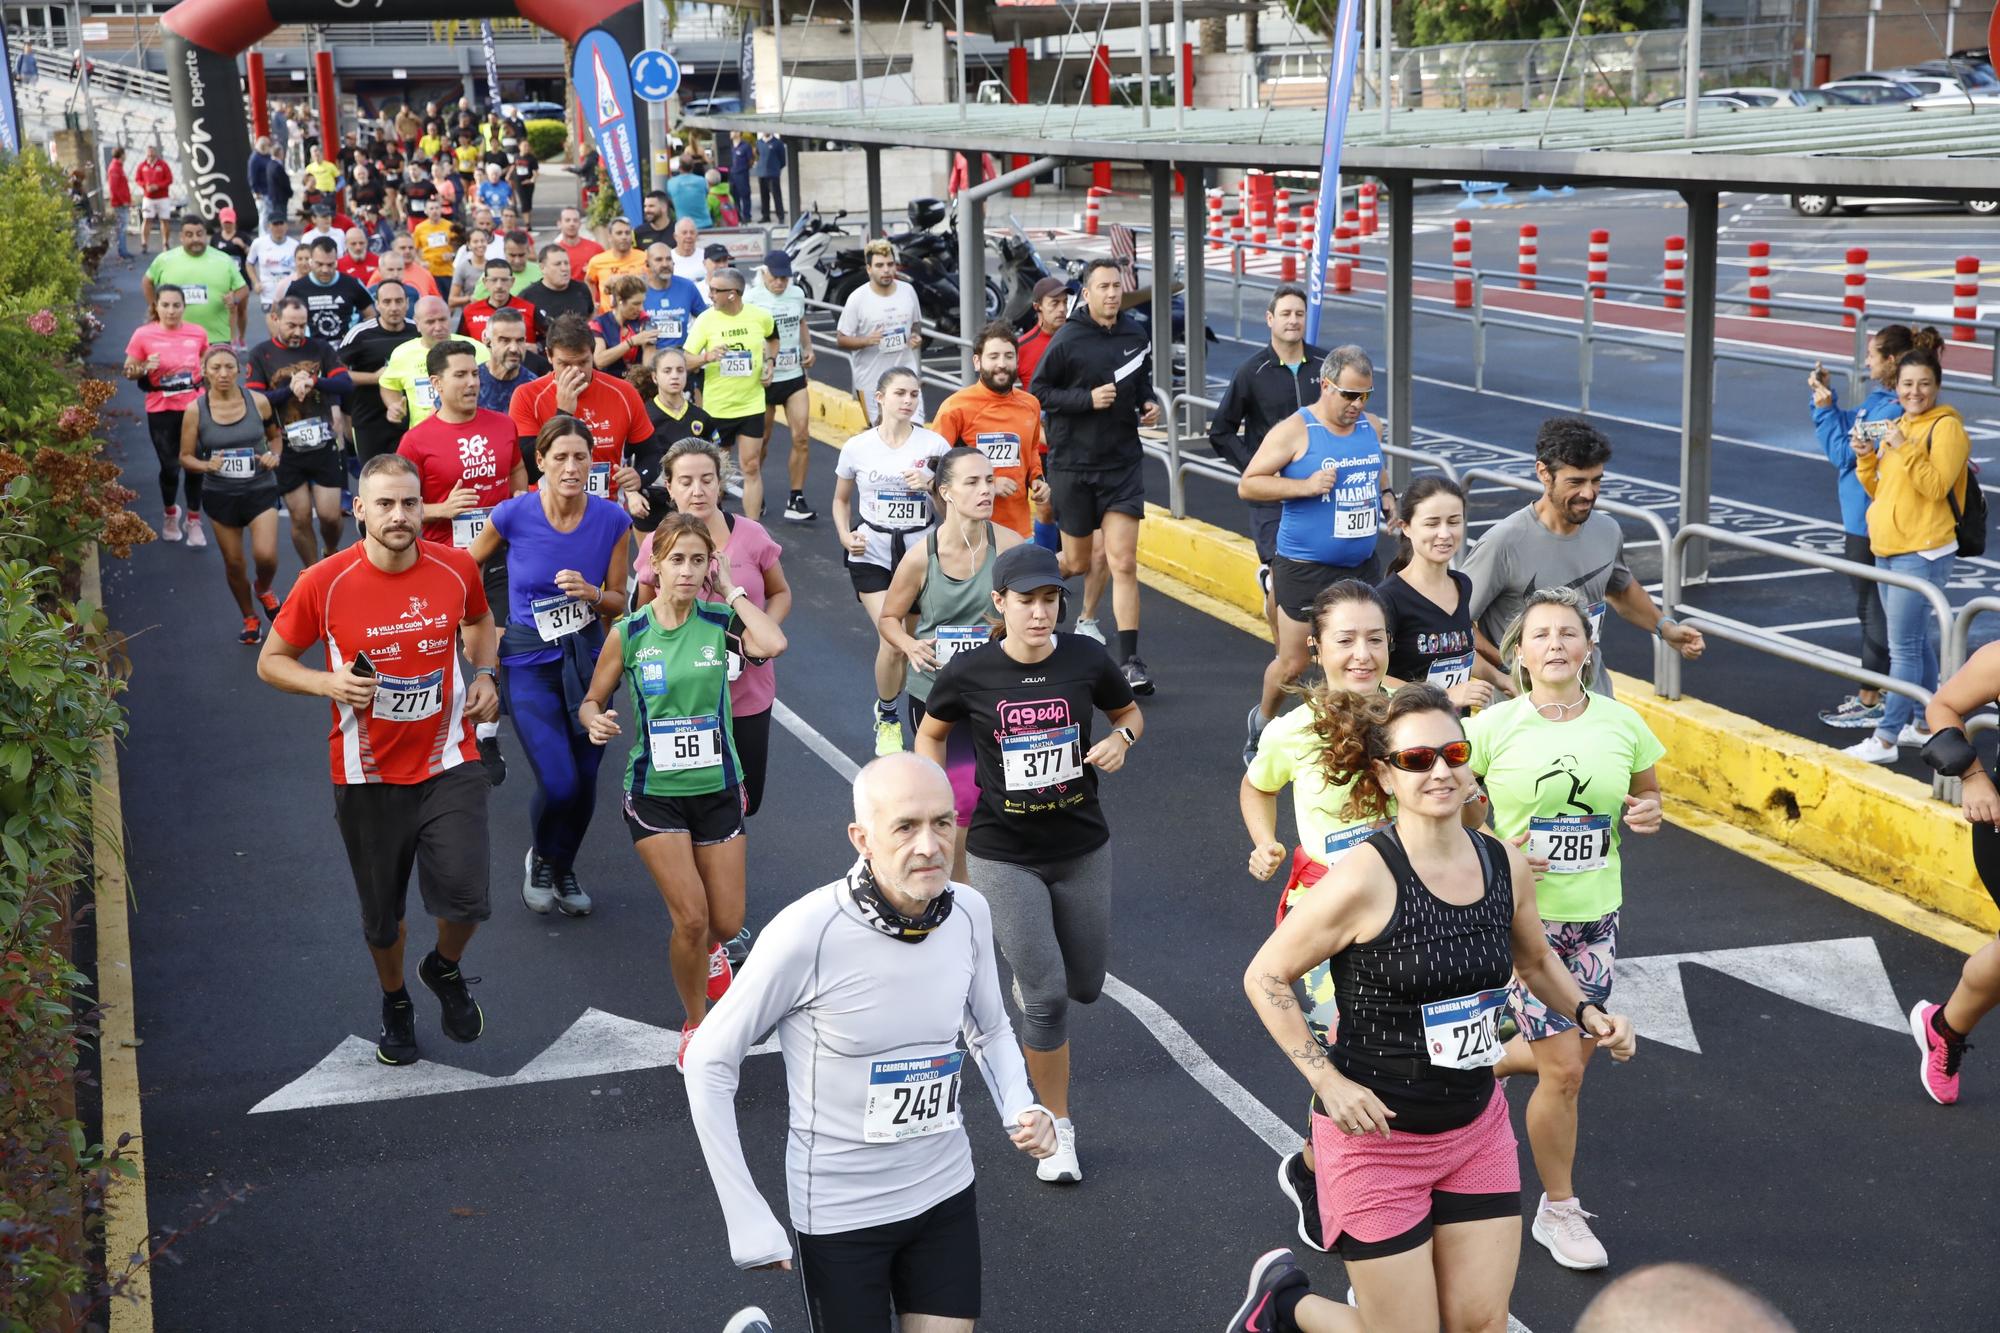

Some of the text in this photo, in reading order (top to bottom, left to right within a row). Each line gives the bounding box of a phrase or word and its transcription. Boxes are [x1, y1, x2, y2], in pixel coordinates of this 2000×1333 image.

[186, 50, 206, 107] Deporte
[885, 335, 901, 348] 229
[727, 360, 745, 371] 255
[300, 429, 314, 443] 53
[457, 435, 482, 461] 36
[988, 444, 1012, 460] 222
[224, 459, 243, 472] 219
[462, 455, 487, 467] VILLA
[1322, 456, 1380, 470] mediolanum
[463, 464, 496, 482] GIJÓN
[1335, 482, 1377, 502] MARIÑA
[887, 502, 915, 519] 239
[1347, 511, 1371, 531] 307
[549, 603, 583, 629] 374
[366, 627, 380, 637] 34
[404, 621, 423, 629] GIJÓN
[635, 646, 663, 663] gijón
[694, 660, 711, 668] Santa
[391, 690, 430, 713] 277
[1029, 733, 1048, 742] POPULAR
[1029, 740, 1054, 750] MARINA
[674, 735, 699, 759] 56
[1023, 748, 1063, 778] 377
[1552, 824, 1591, 832] SUPERGIRL
[1548, 834, 1593, 861] 286
[1427, 1007, 1434, 1016] IX
[1434, 1003, 1461, 1014] CARRERA
[1453, 1015, 1493, 1062] 220
[875, 1065, 882, 1074] IX
[882, 1062, 908, 1073] CARRERA
[908, 1059, 932, 1072] POPULAR
[904, 1070, 939, 1083] ANTONIO
[892, 1082, 943, 1125] 249
